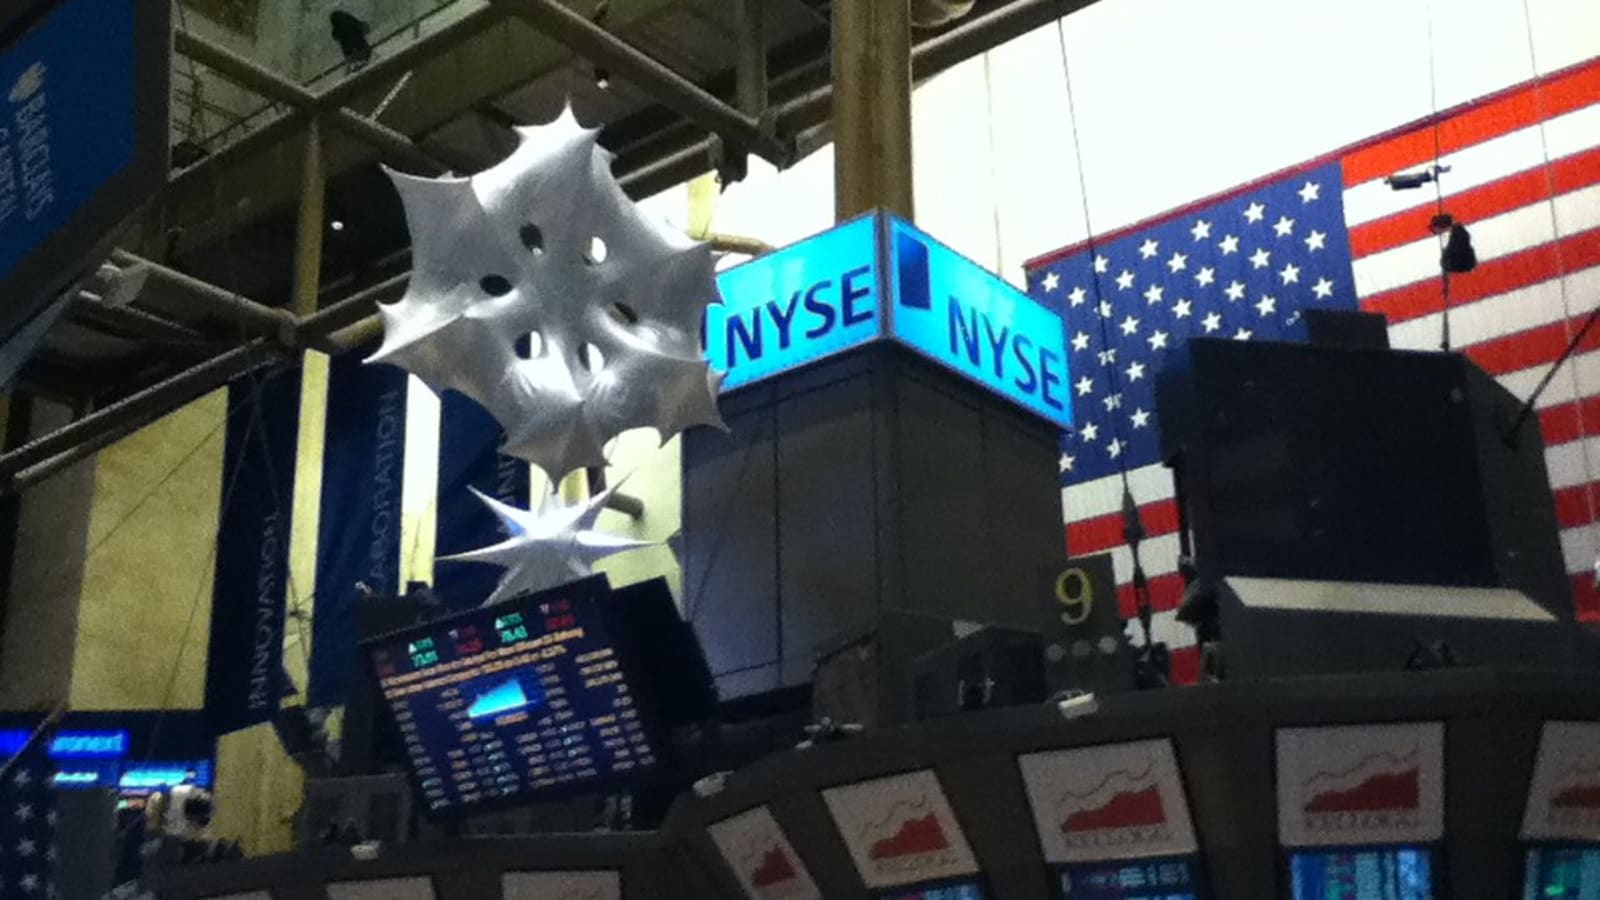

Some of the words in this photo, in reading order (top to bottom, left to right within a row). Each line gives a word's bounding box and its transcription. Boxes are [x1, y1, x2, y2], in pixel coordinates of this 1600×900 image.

[726, 265, 874, 369] NYSE
[949, 294, 1064, 411] NYSE
[369, 390, 399, 580] ABORATION
[248, 508, 279, 709] INNOVATION
[1055, 567, 1092, 625] 9
